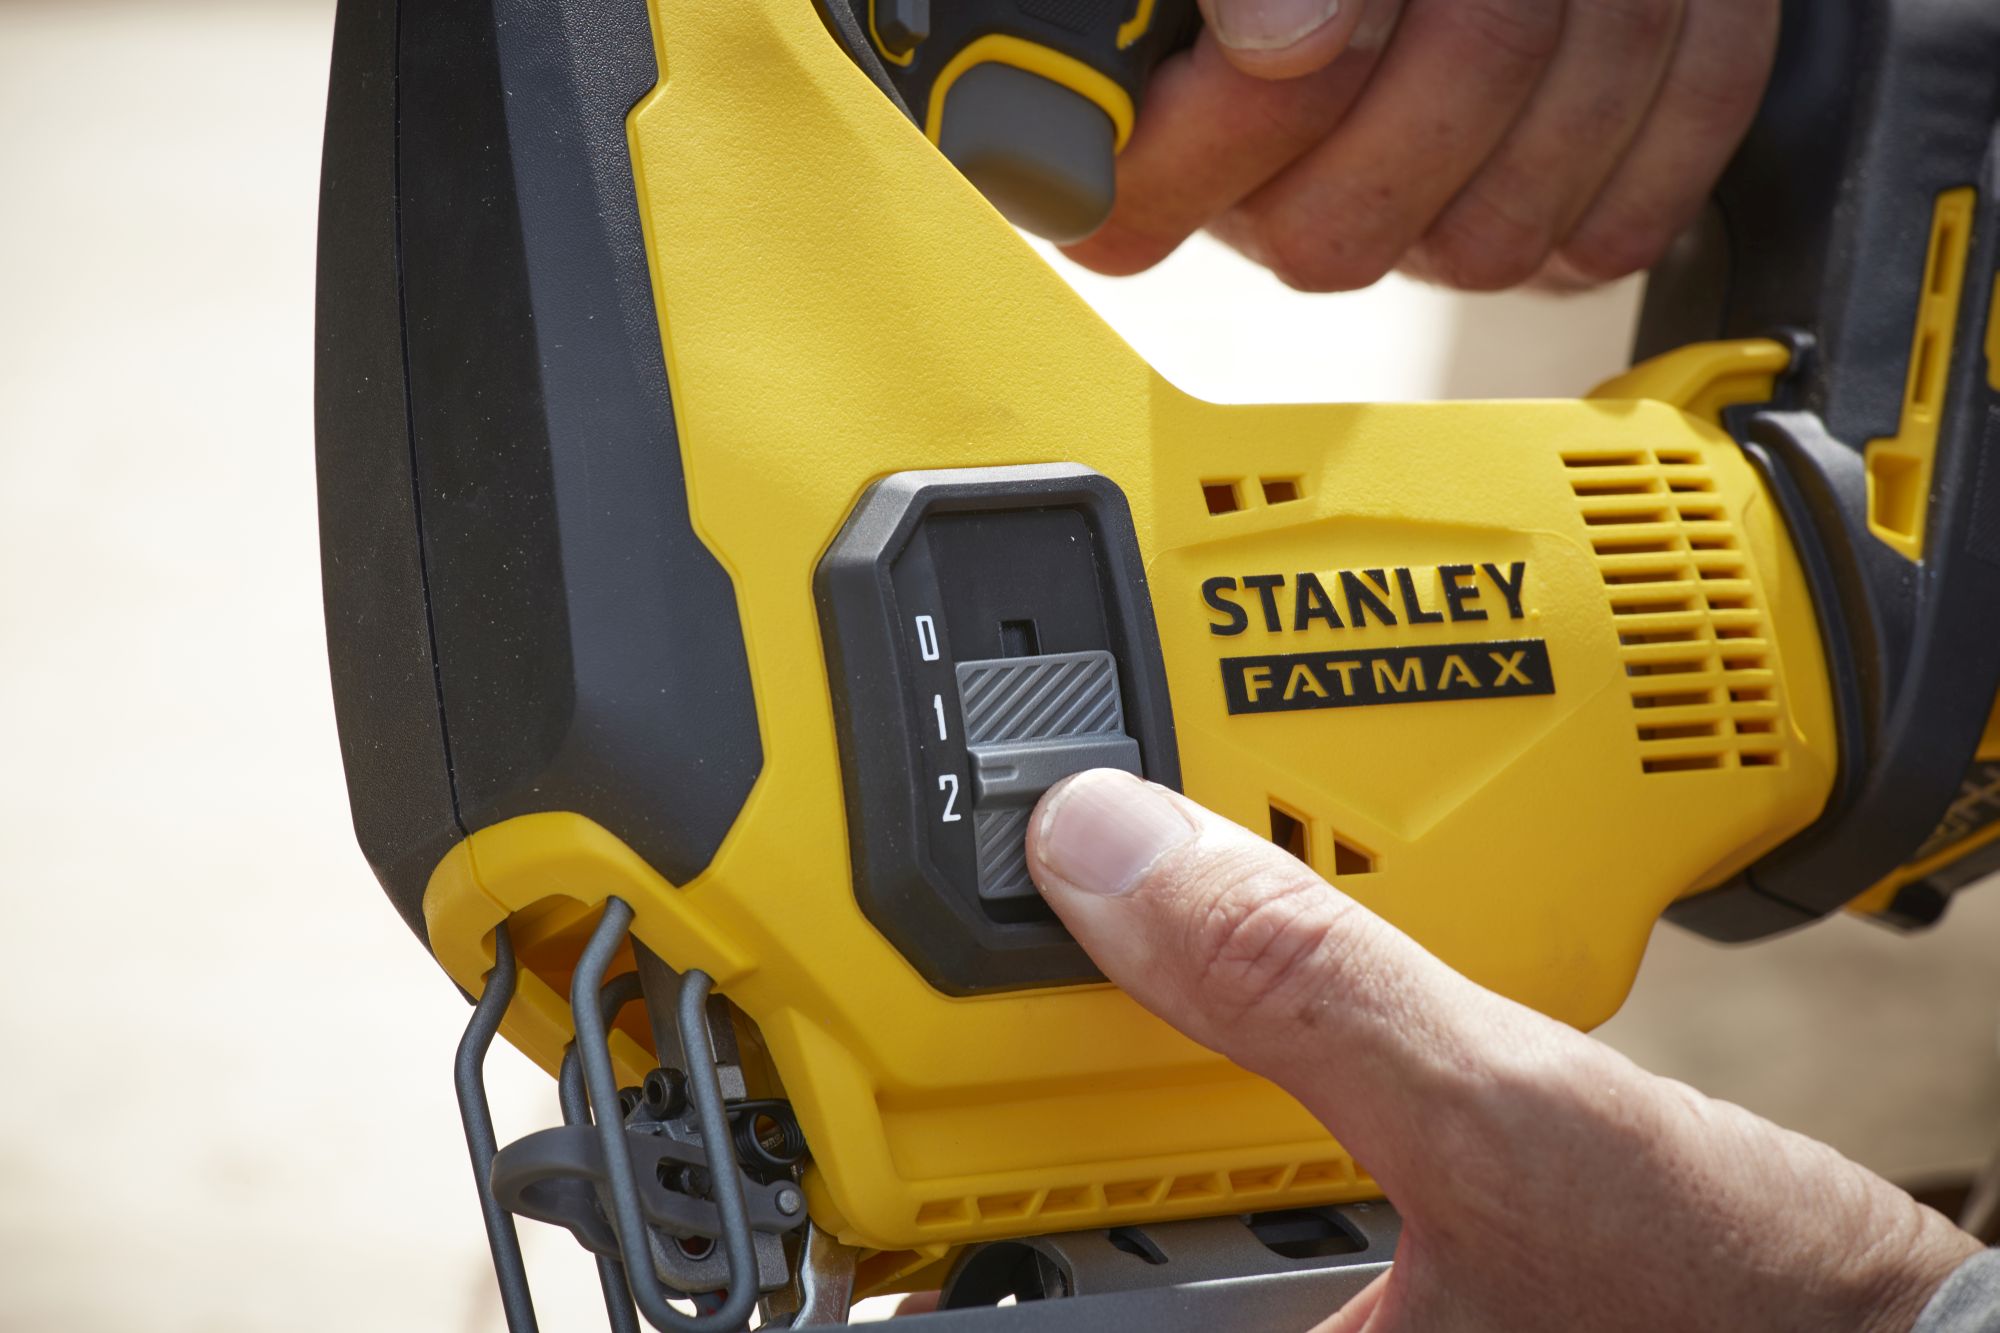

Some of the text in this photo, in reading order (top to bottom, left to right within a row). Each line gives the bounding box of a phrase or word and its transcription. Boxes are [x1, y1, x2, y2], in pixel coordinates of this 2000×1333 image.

[1201, 562, 1526, 637] STANLEY
[915, 615, 940, 661] 0
[1243, 651, 1533, 702] FATMAX
[933, 694, 947, 741] 1
[938, 774, 962, 822] 2
